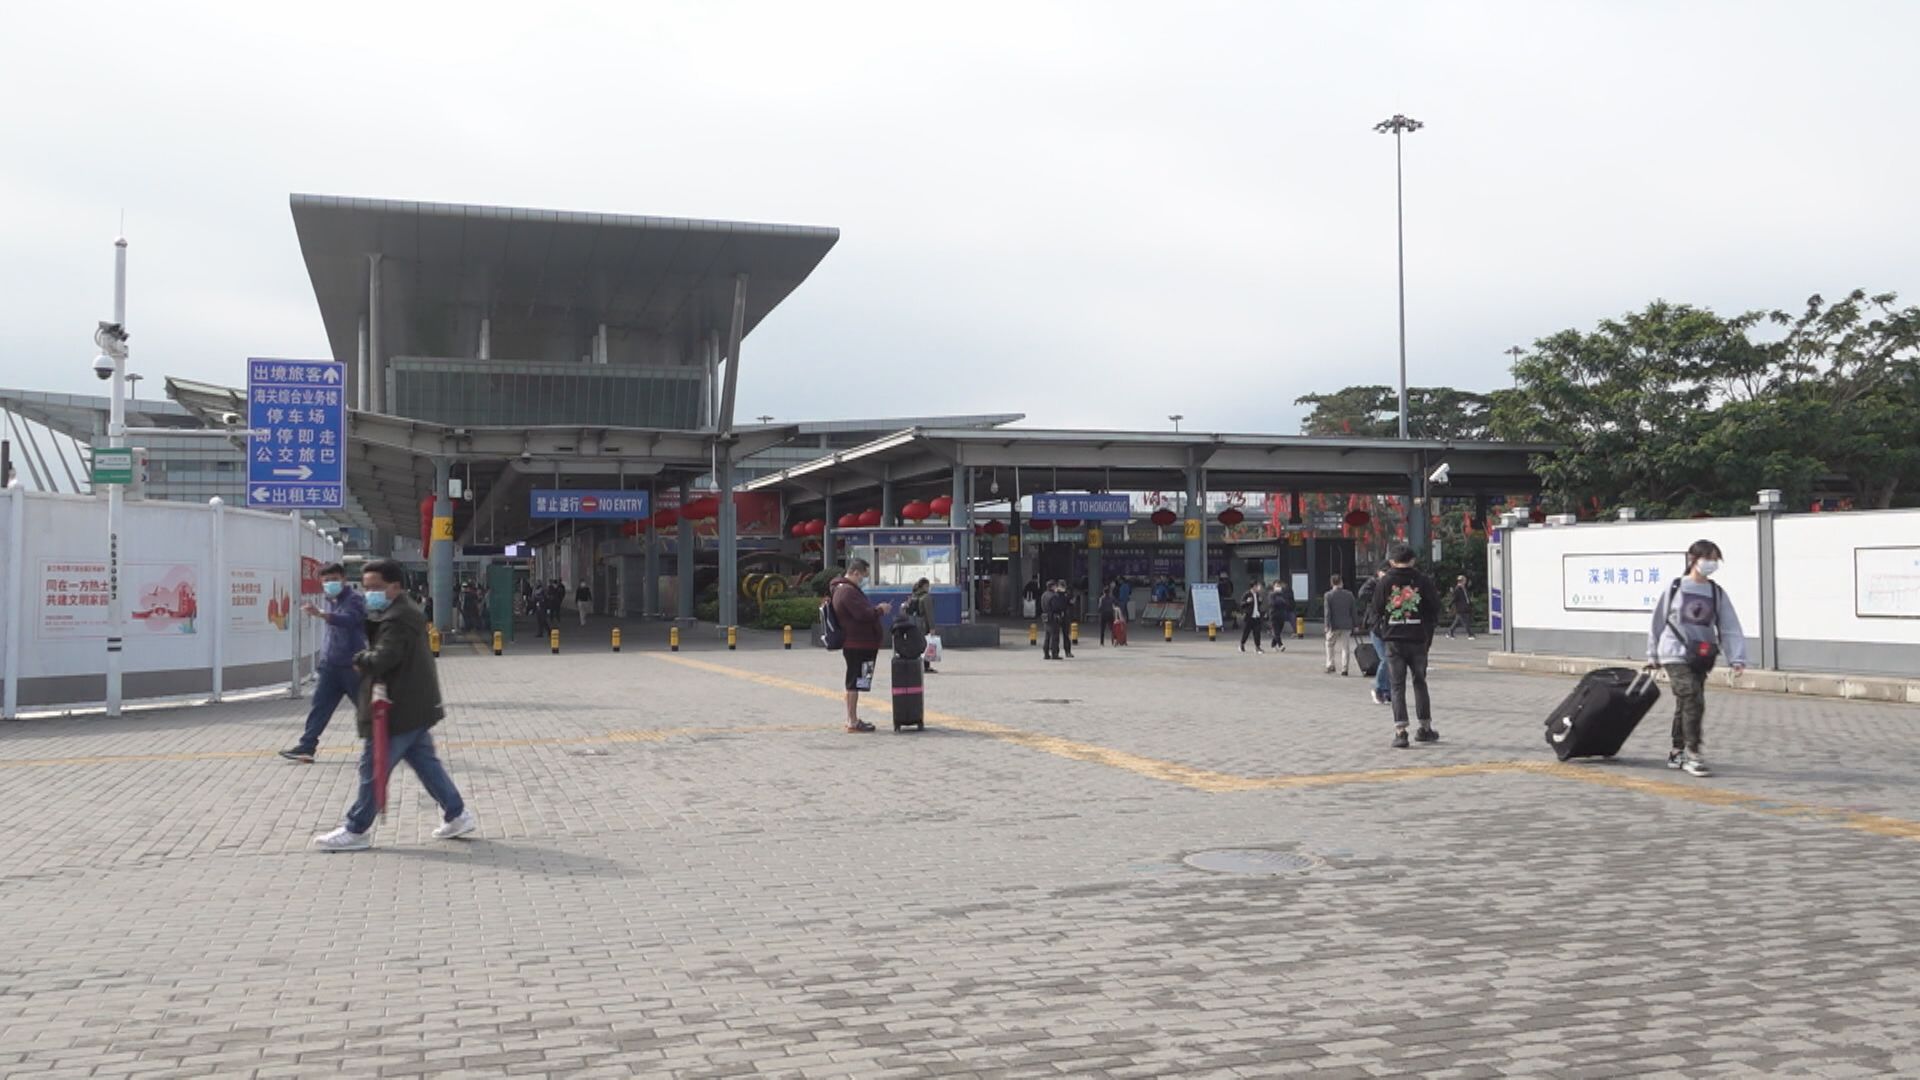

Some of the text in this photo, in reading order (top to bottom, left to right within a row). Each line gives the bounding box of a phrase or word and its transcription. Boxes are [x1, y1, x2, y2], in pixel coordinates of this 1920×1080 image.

[253, 365, 322, 382] 出境旅客
[254, 388, 338, 406] 海关综合业务楼
[266, 407, 325, 425] 停车场
[255, 427, 336, 446] 即停即走
[256, 446, 336, 464] 公交旅巴
[272, 488, 338, 503] 出租车站
[537, 497, 580, 513] 禁止逆行
[598, 499, 613, 512] NO
[614, 498, 643, 512] ENTRY
[1037, 499, 1069, 514] 往香港
[1079, 500, 1089, 512] TO
[1589, 567, 1660, 584] 深圳湾口岸
